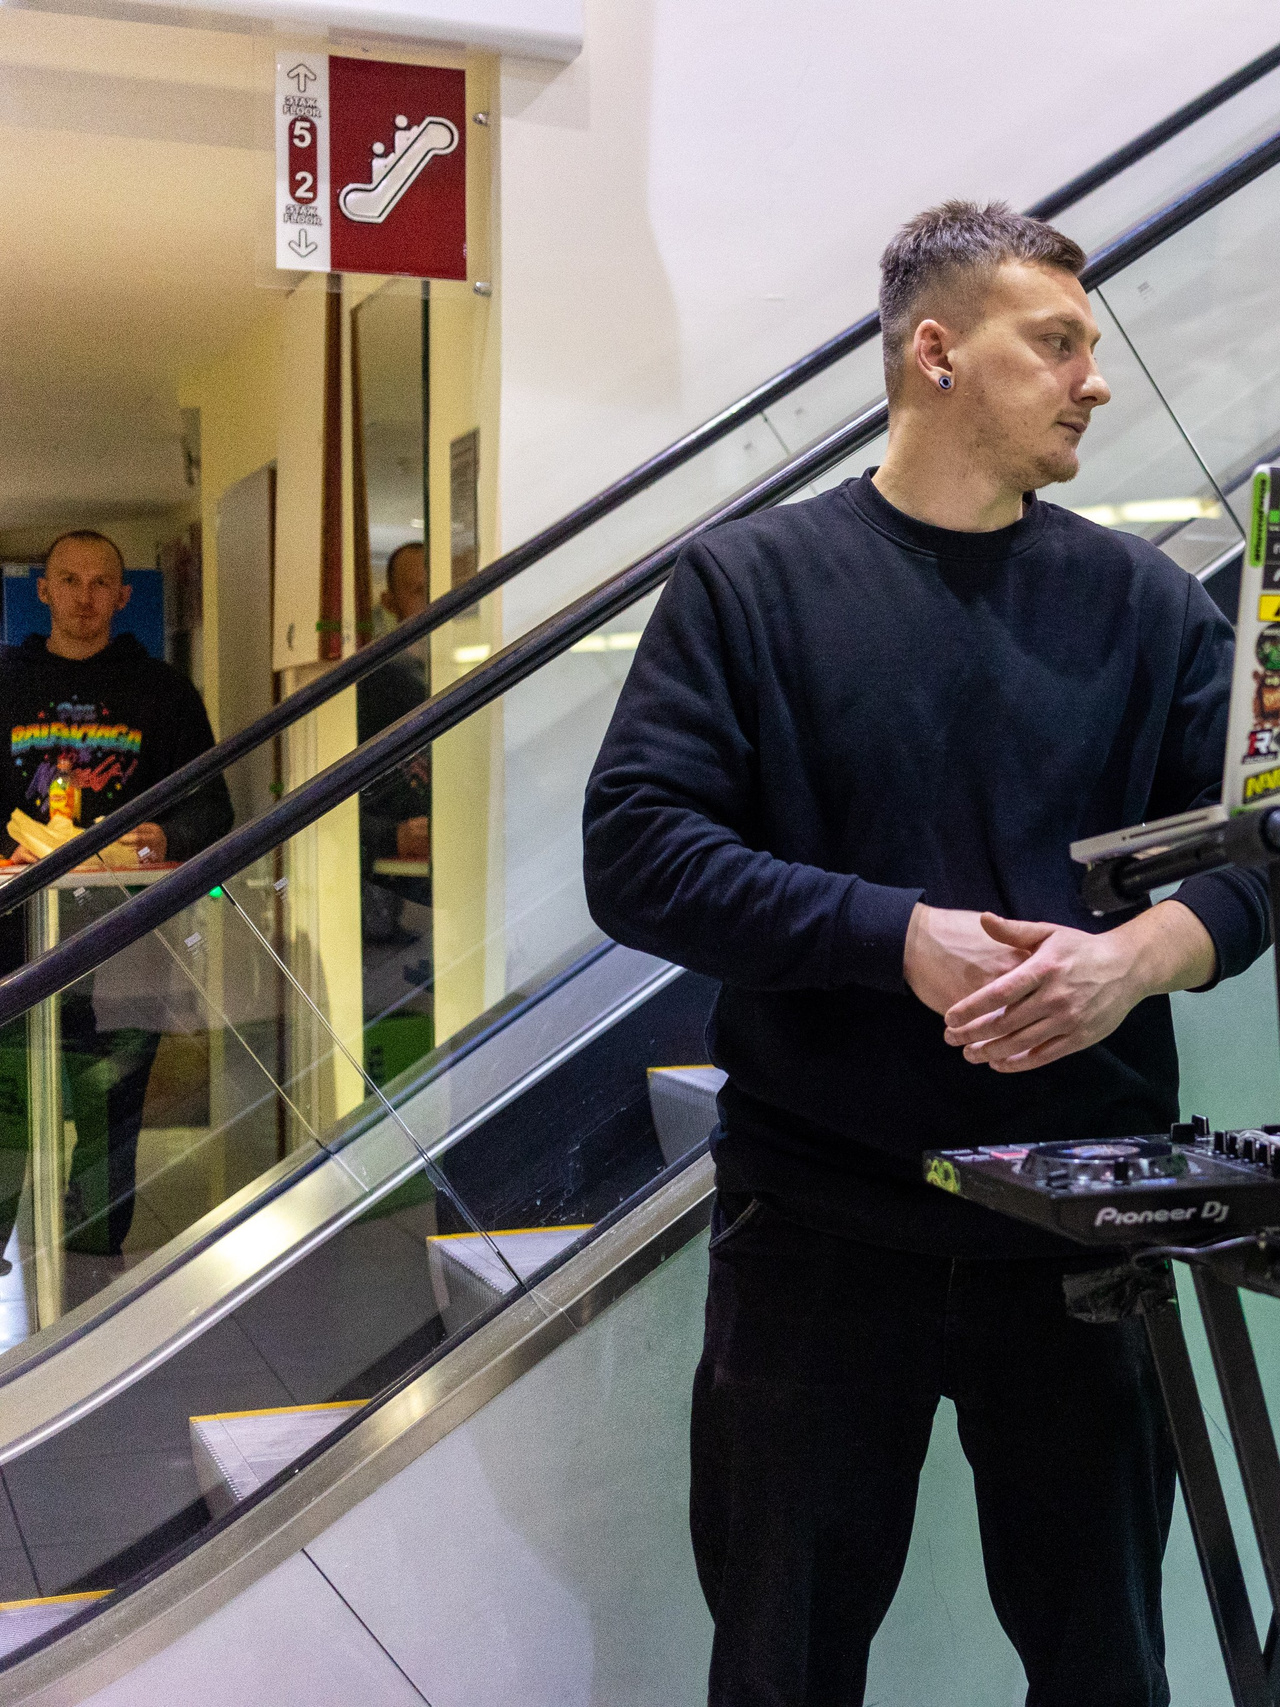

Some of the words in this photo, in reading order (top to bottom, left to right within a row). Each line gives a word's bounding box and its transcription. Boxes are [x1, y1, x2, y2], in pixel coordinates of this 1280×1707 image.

[283, 104, 322, 118] FLOOR
[293, 120, 312, 148] 5
[294, 171, 314, 199] 2
[283, 213, 322, 226] FLOOR
[1094, 1206, 1197, 1228] Pioneer
